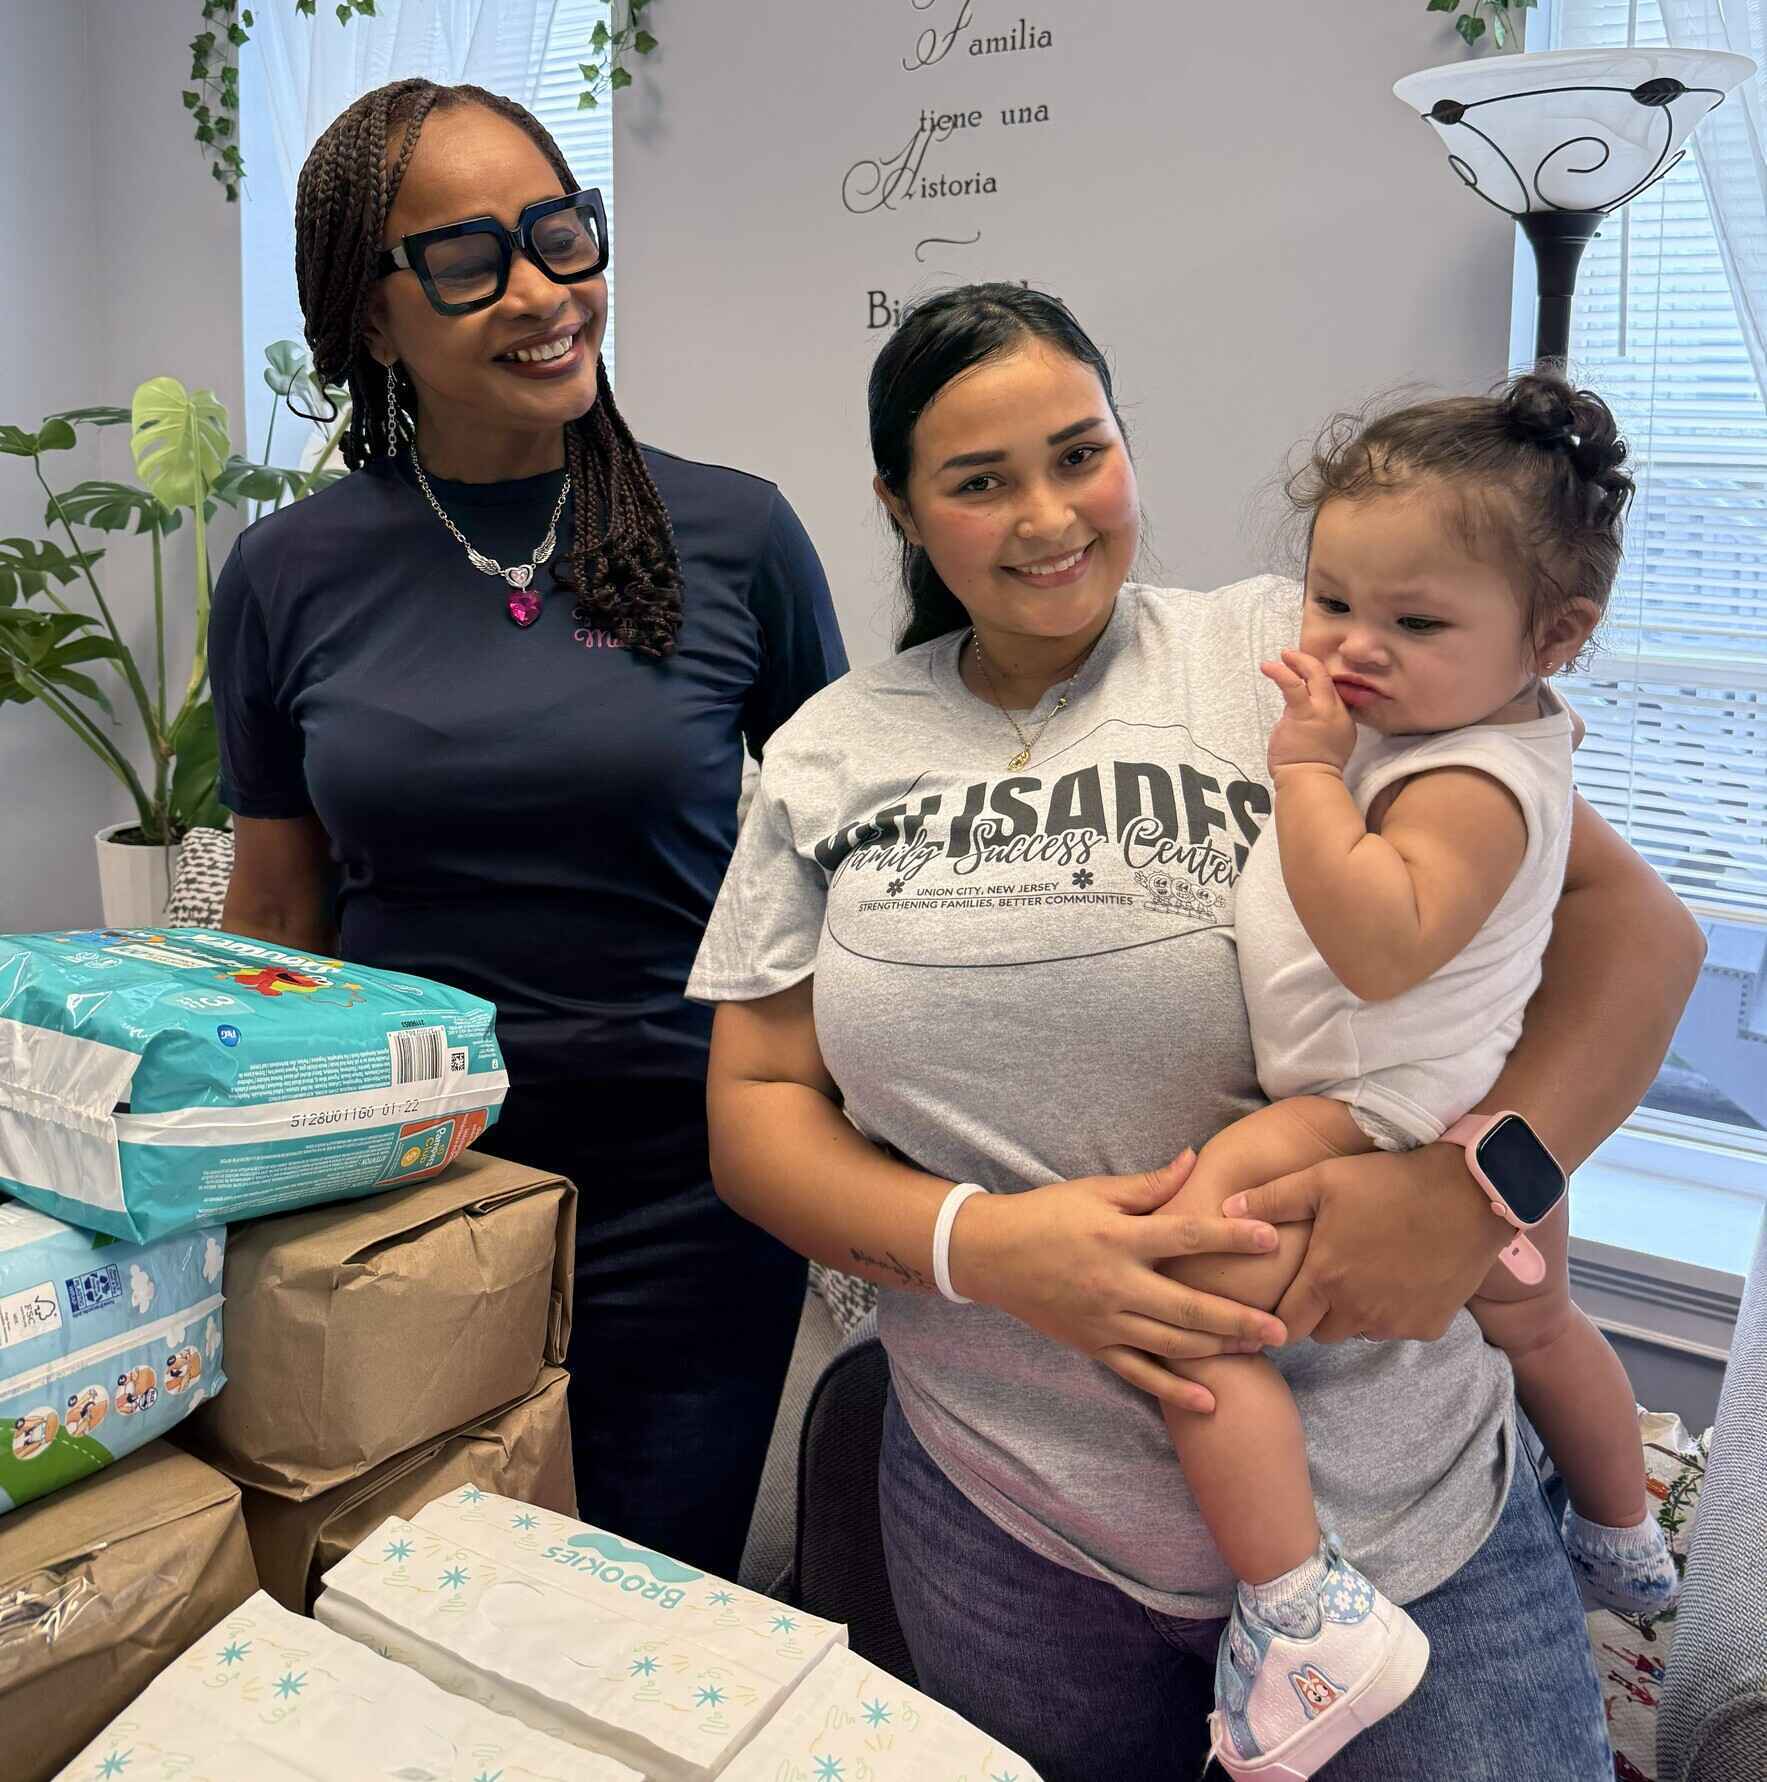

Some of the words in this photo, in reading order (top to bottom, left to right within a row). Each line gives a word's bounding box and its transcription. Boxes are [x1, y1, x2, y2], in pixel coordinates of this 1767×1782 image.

[920, 109, 982, 132] tiene
[1001, 104, 1049, 126] una
[843, 118, 998, 214] Historia
[833, 828, 944, 888] Family
[953, 822, 1106, 875] Success
[858, 899, 939, 912] STRENGTHENING
[941, 898, 995, 910] FAMILIES,
[999, 896, 1043, 908] BETTER
[1045, 894, 1134, 906] COMMUNITIES
[917, 888, 953, 897] UNION
[956, 887, 985, 897] CITY,
[987, 885, 1014, 895] NEW
[1017, 882, 1059, 894] JERSEY
[541, 1545, 687, 1610] BROOKIES
